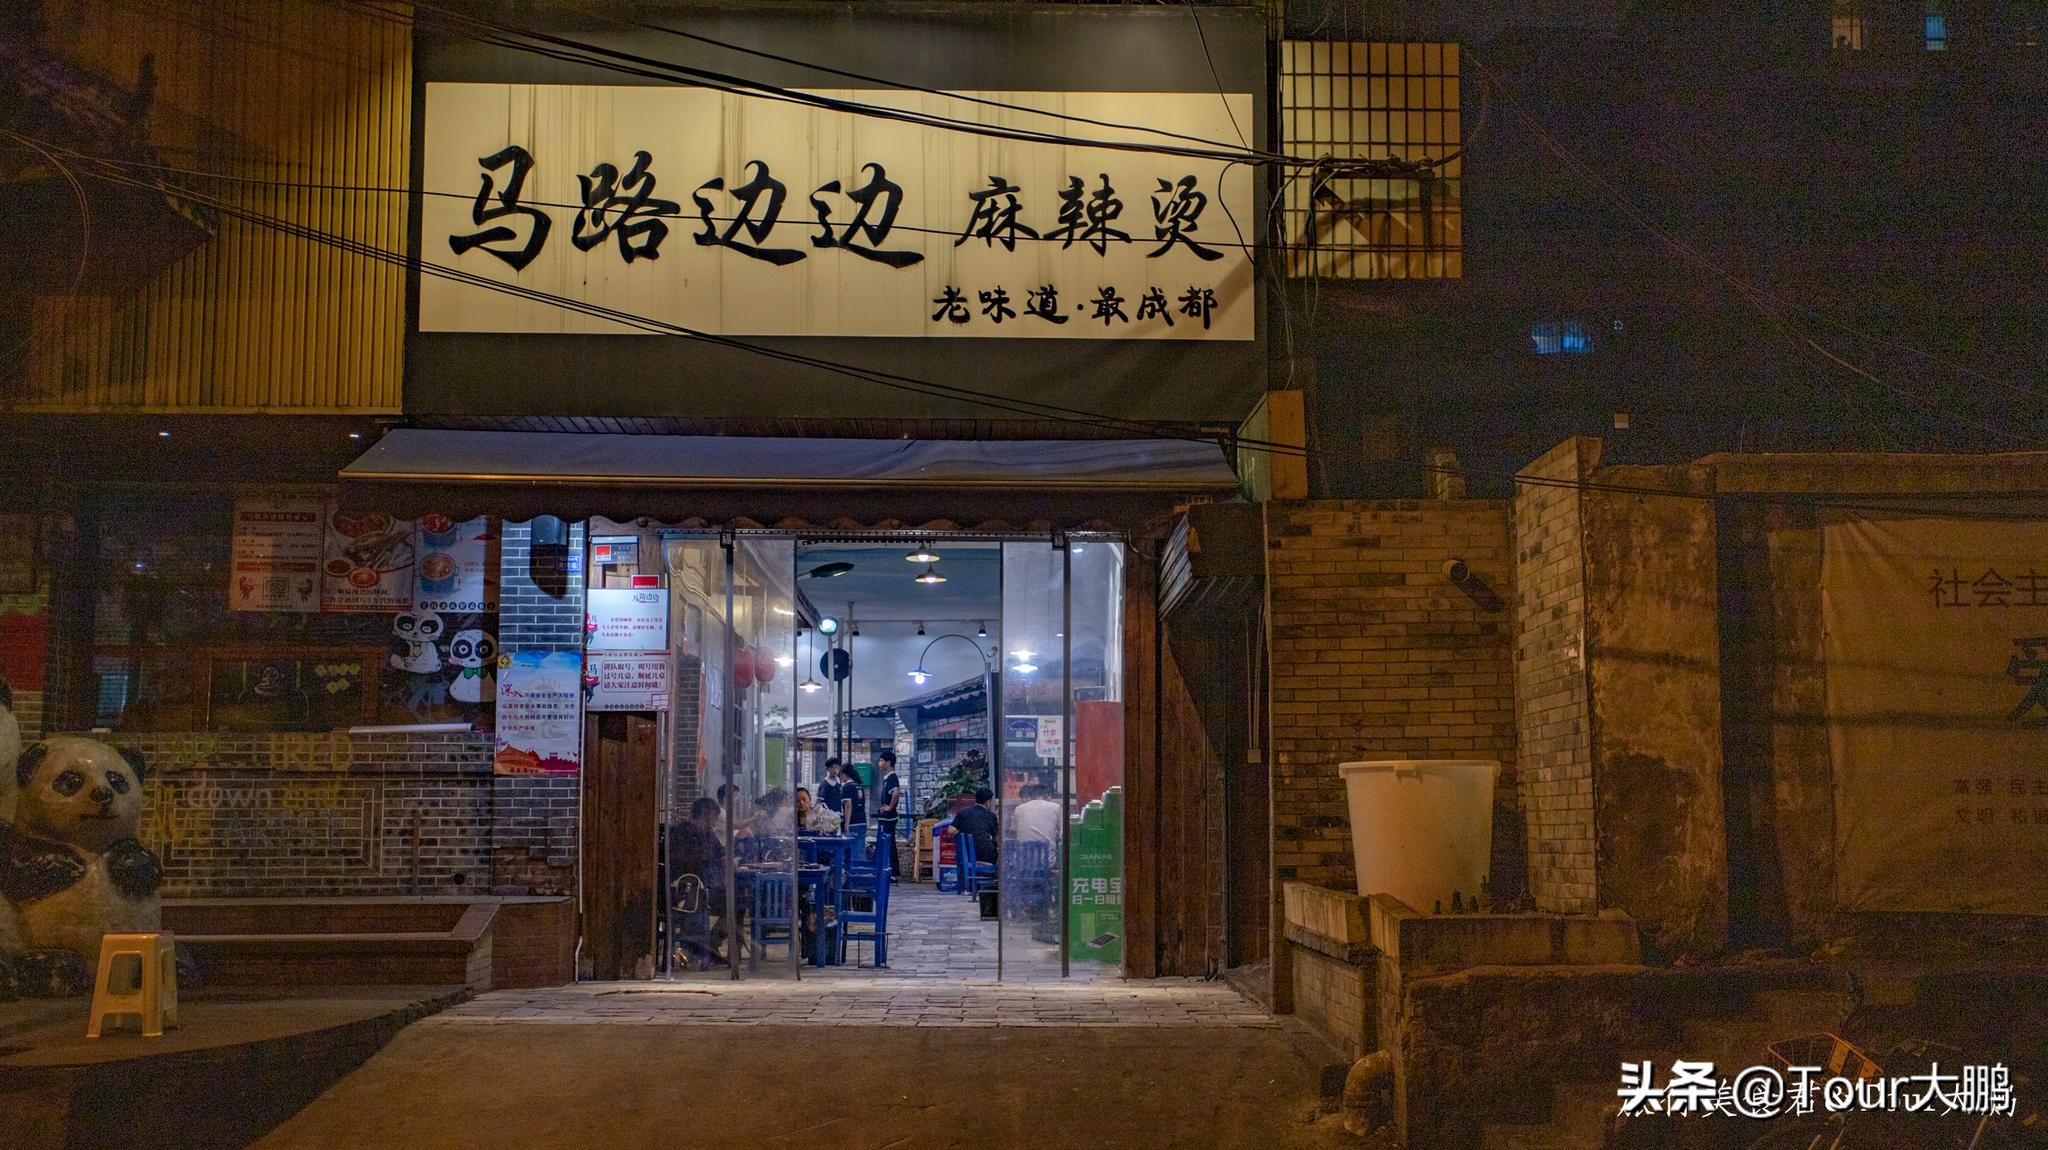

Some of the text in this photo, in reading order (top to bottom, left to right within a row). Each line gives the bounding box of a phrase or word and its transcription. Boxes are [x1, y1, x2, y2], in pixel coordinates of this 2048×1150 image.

[449, 145, 1225, 272] 马路边边 麻辣烫
[932, 284, 1220, 330] 老味道·最成都
[1927, 567, 2048, 609] 社会主
